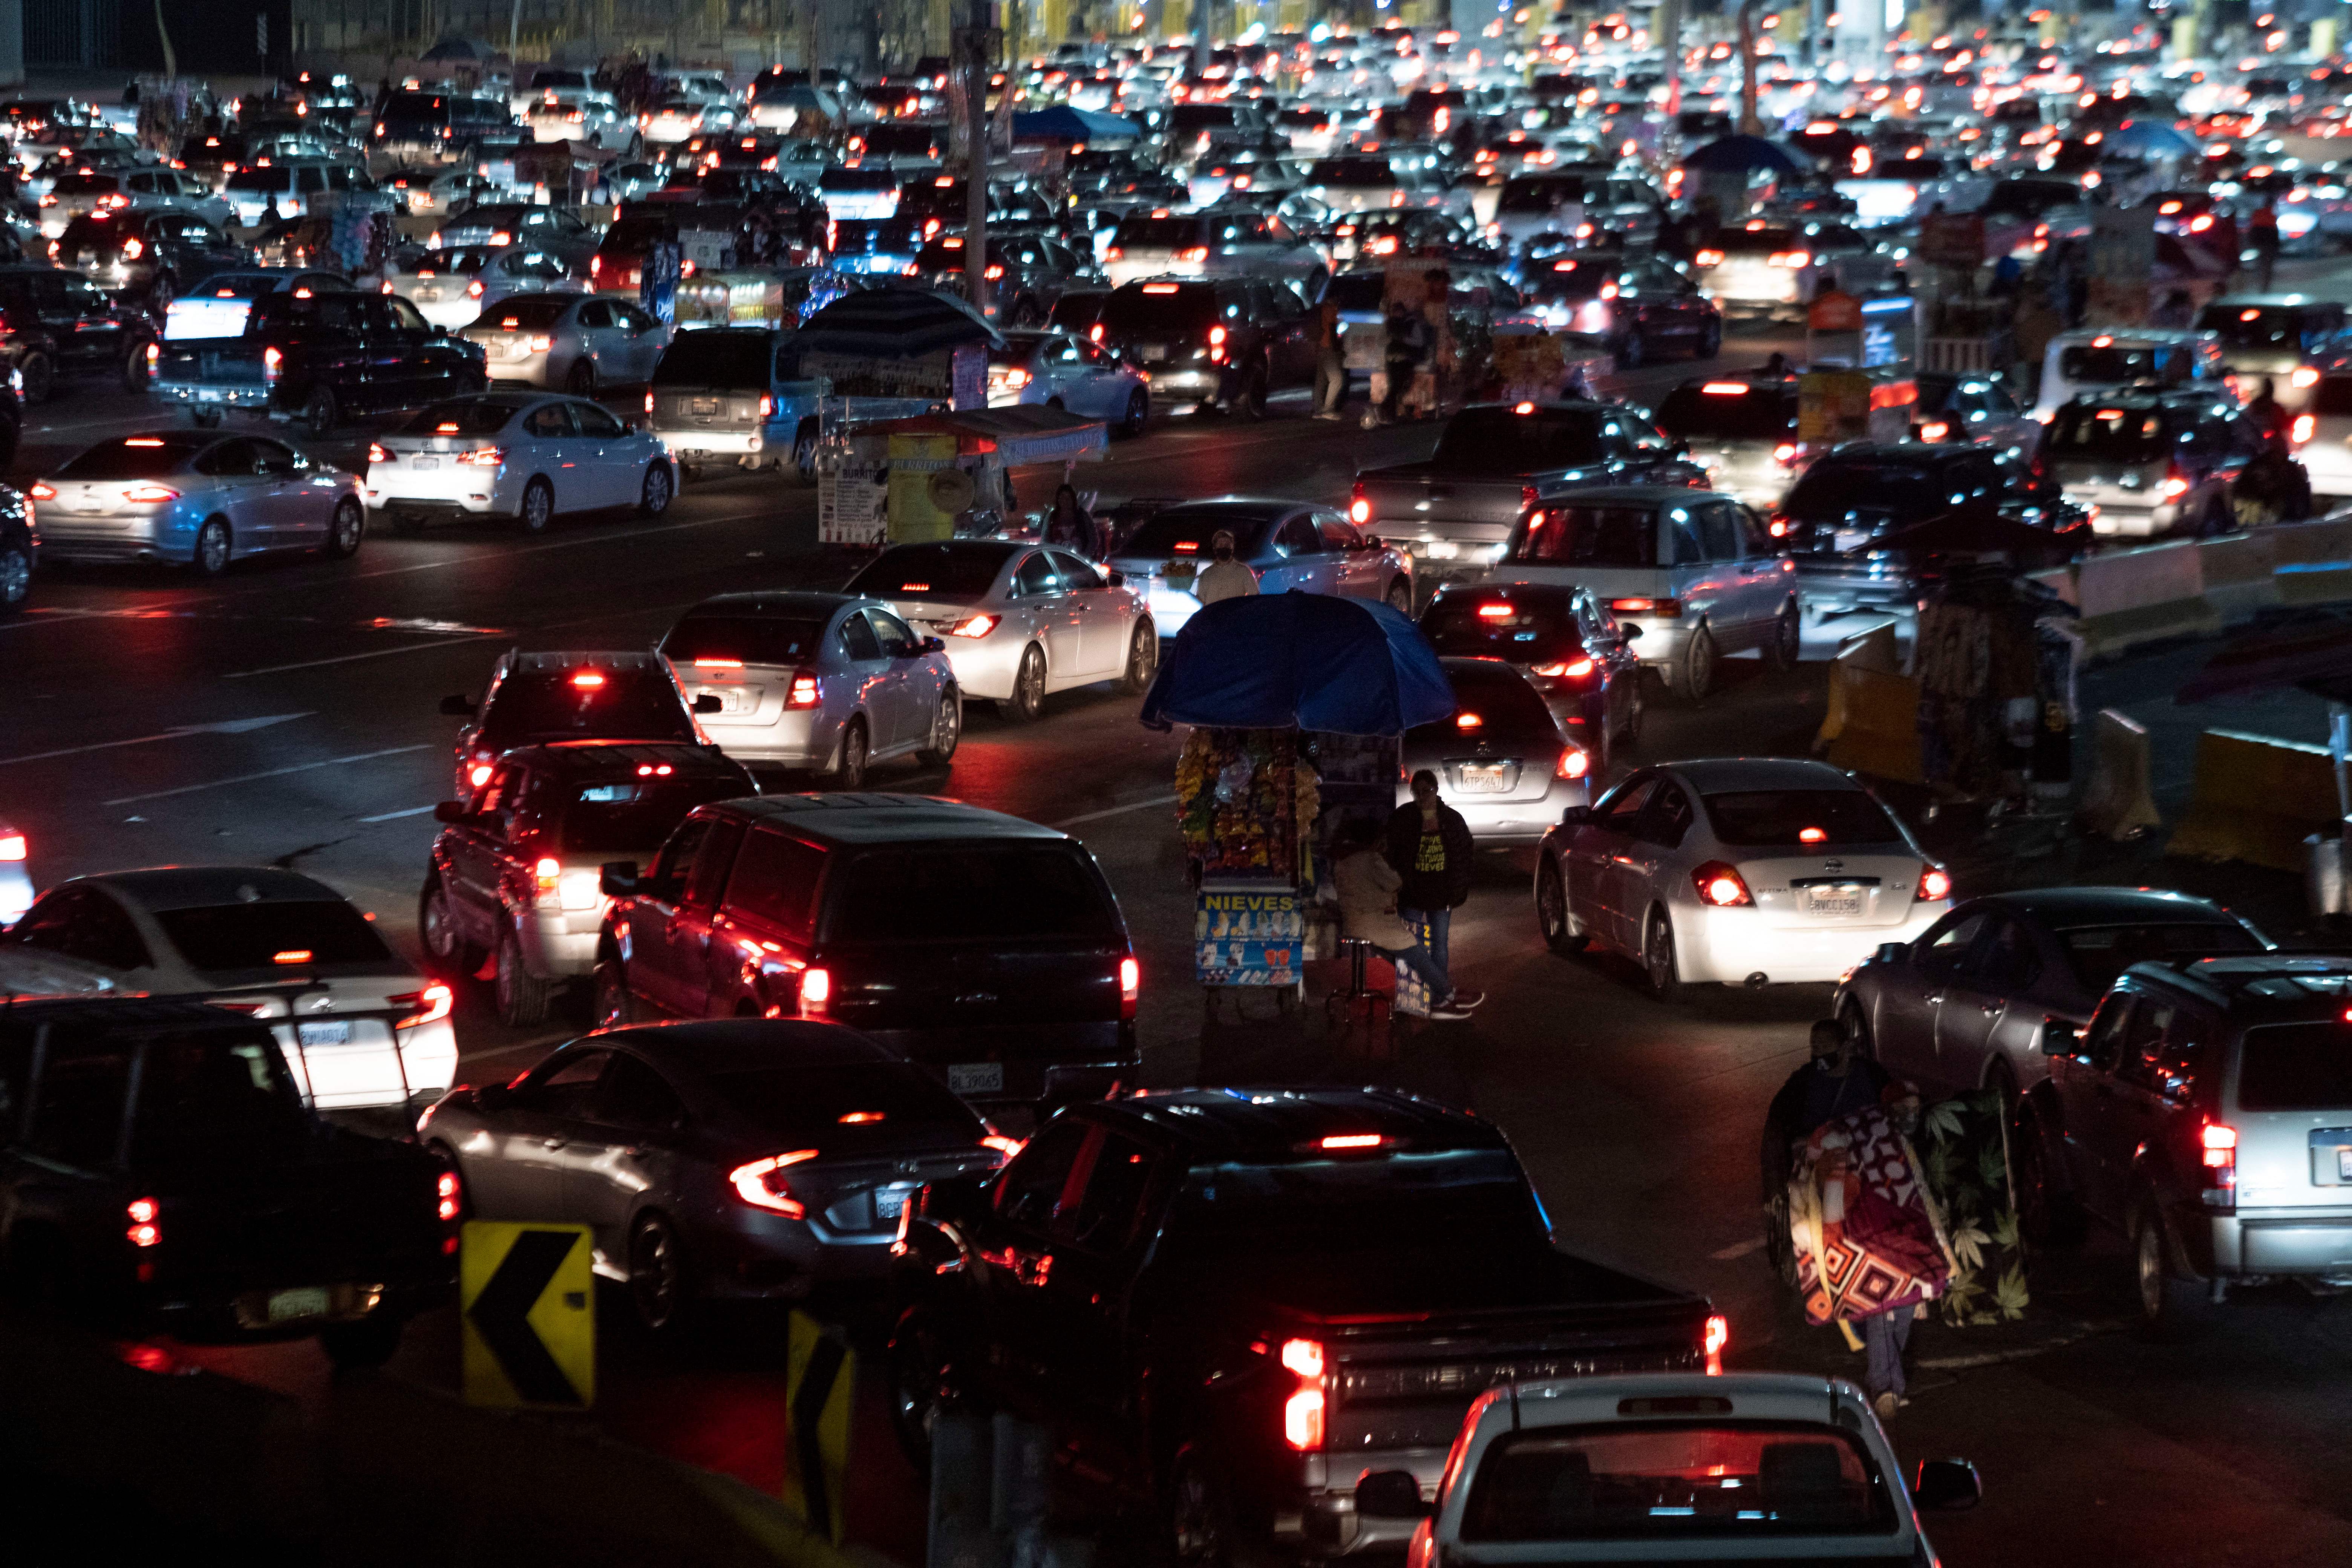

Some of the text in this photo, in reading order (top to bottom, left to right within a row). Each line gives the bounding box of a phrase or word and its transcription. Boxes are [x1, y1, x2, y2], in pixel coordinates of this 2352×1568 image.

[1464, 776, 1501, 787] 6TPS647
[1415, 862, 1444, 872] NIEVES
[1205, 896, 1294, 911] NIEVES
